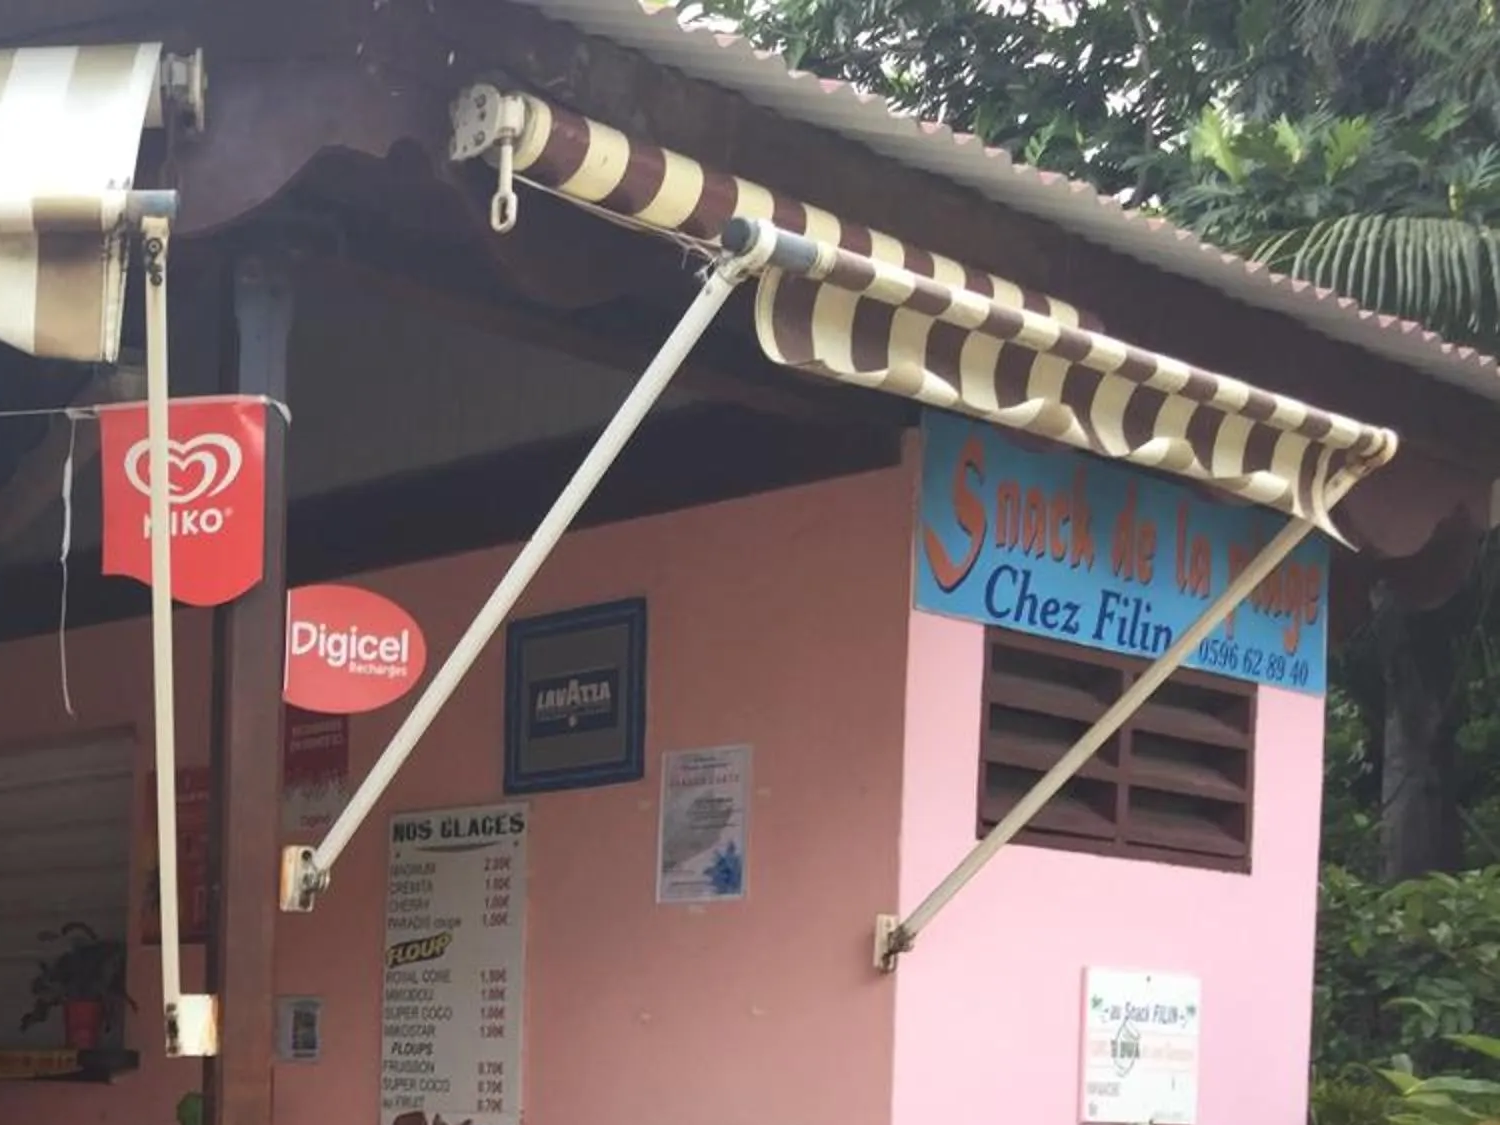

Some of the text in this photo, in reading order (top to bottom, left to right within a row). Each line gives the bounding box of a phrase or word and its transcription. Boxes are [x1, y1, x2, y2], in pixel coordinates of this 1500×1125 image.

[923, 435, 1322, 655] Snack de la page
[984, 564, 1175, 656] Chez Filin
[291, 621, 409, 667] Digicel
[348, 661, 409, 679] Recharges
[1198, 637, 1309, 687] 0596 62 89 40
[537, 679, 611, 708] LAVAZZA
[392, 812, 525, 843] NOS GLACES
[384, 1006, 419, 1021] SUPER
[382, 1077, 417, 1093] SUPER
